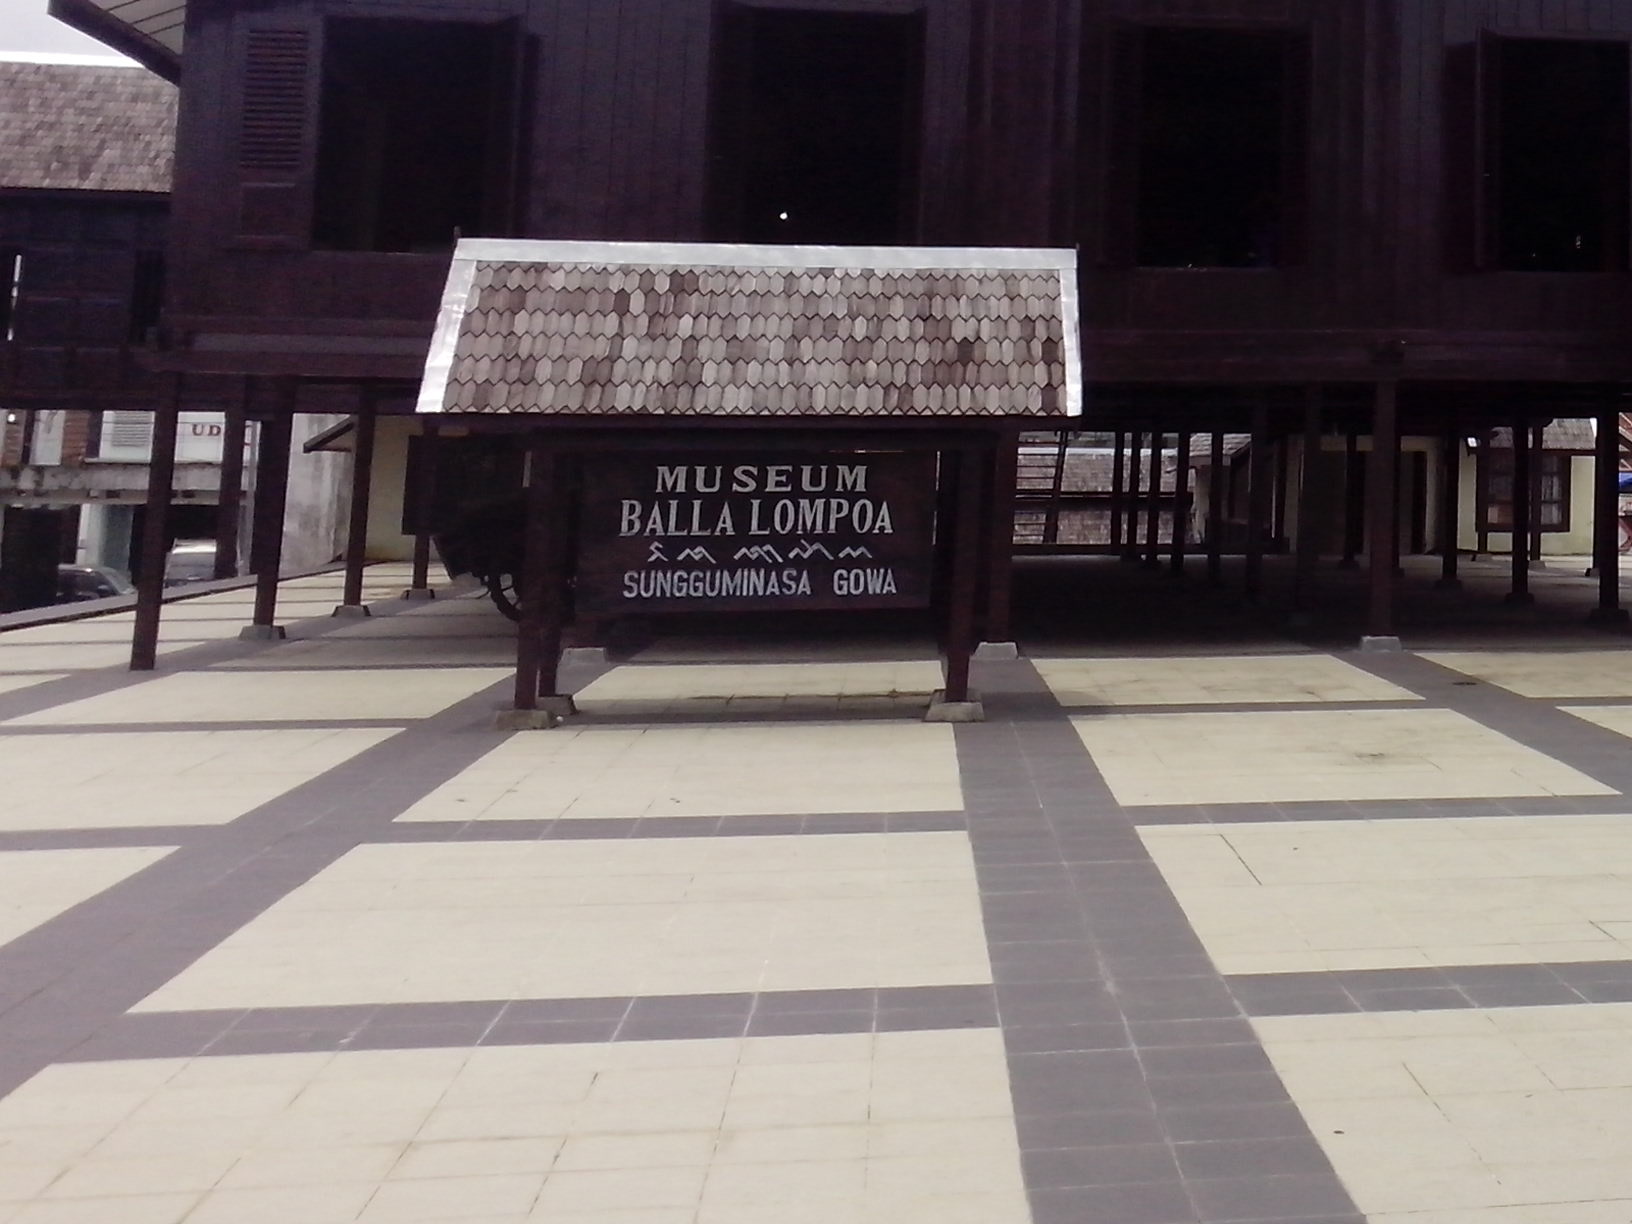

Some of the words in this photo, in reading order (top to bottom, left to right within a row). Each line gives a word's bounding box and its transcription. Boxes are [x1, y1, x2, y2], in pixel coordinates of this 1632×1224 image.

[655, 464, 868, 493] MUSEUM
[619, 499, 736, 537] BALLA
[748, 498, 894, 535] LOMPOA
[622, 567, 812, 598] SUNGGUMINASA
[833, 567, 897, 596] GOWA
